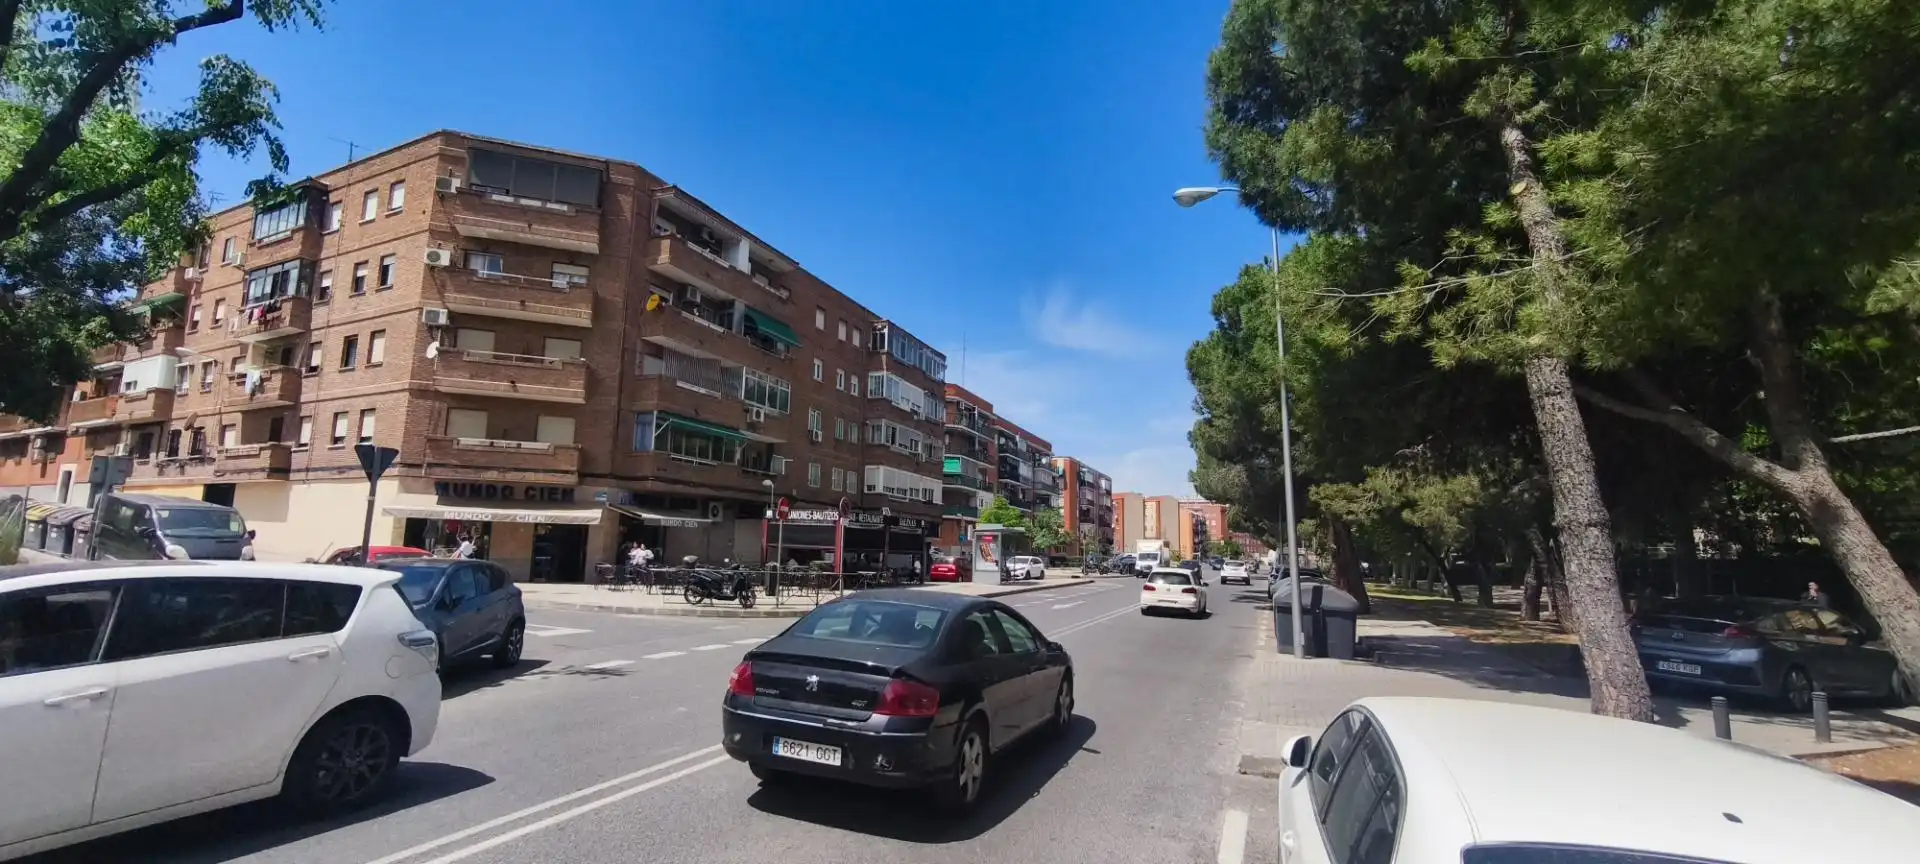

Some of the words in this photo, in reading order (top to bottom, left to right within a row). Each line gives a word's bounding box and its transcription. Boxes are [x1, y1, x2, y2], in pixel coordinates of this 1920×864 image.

[435, 481, 514, 499] MUNDO
[524, 485, 575, 503] CIEN
[444, 511, 492, 520] MUNDO
[516, 513, 545, 522] CIEN
